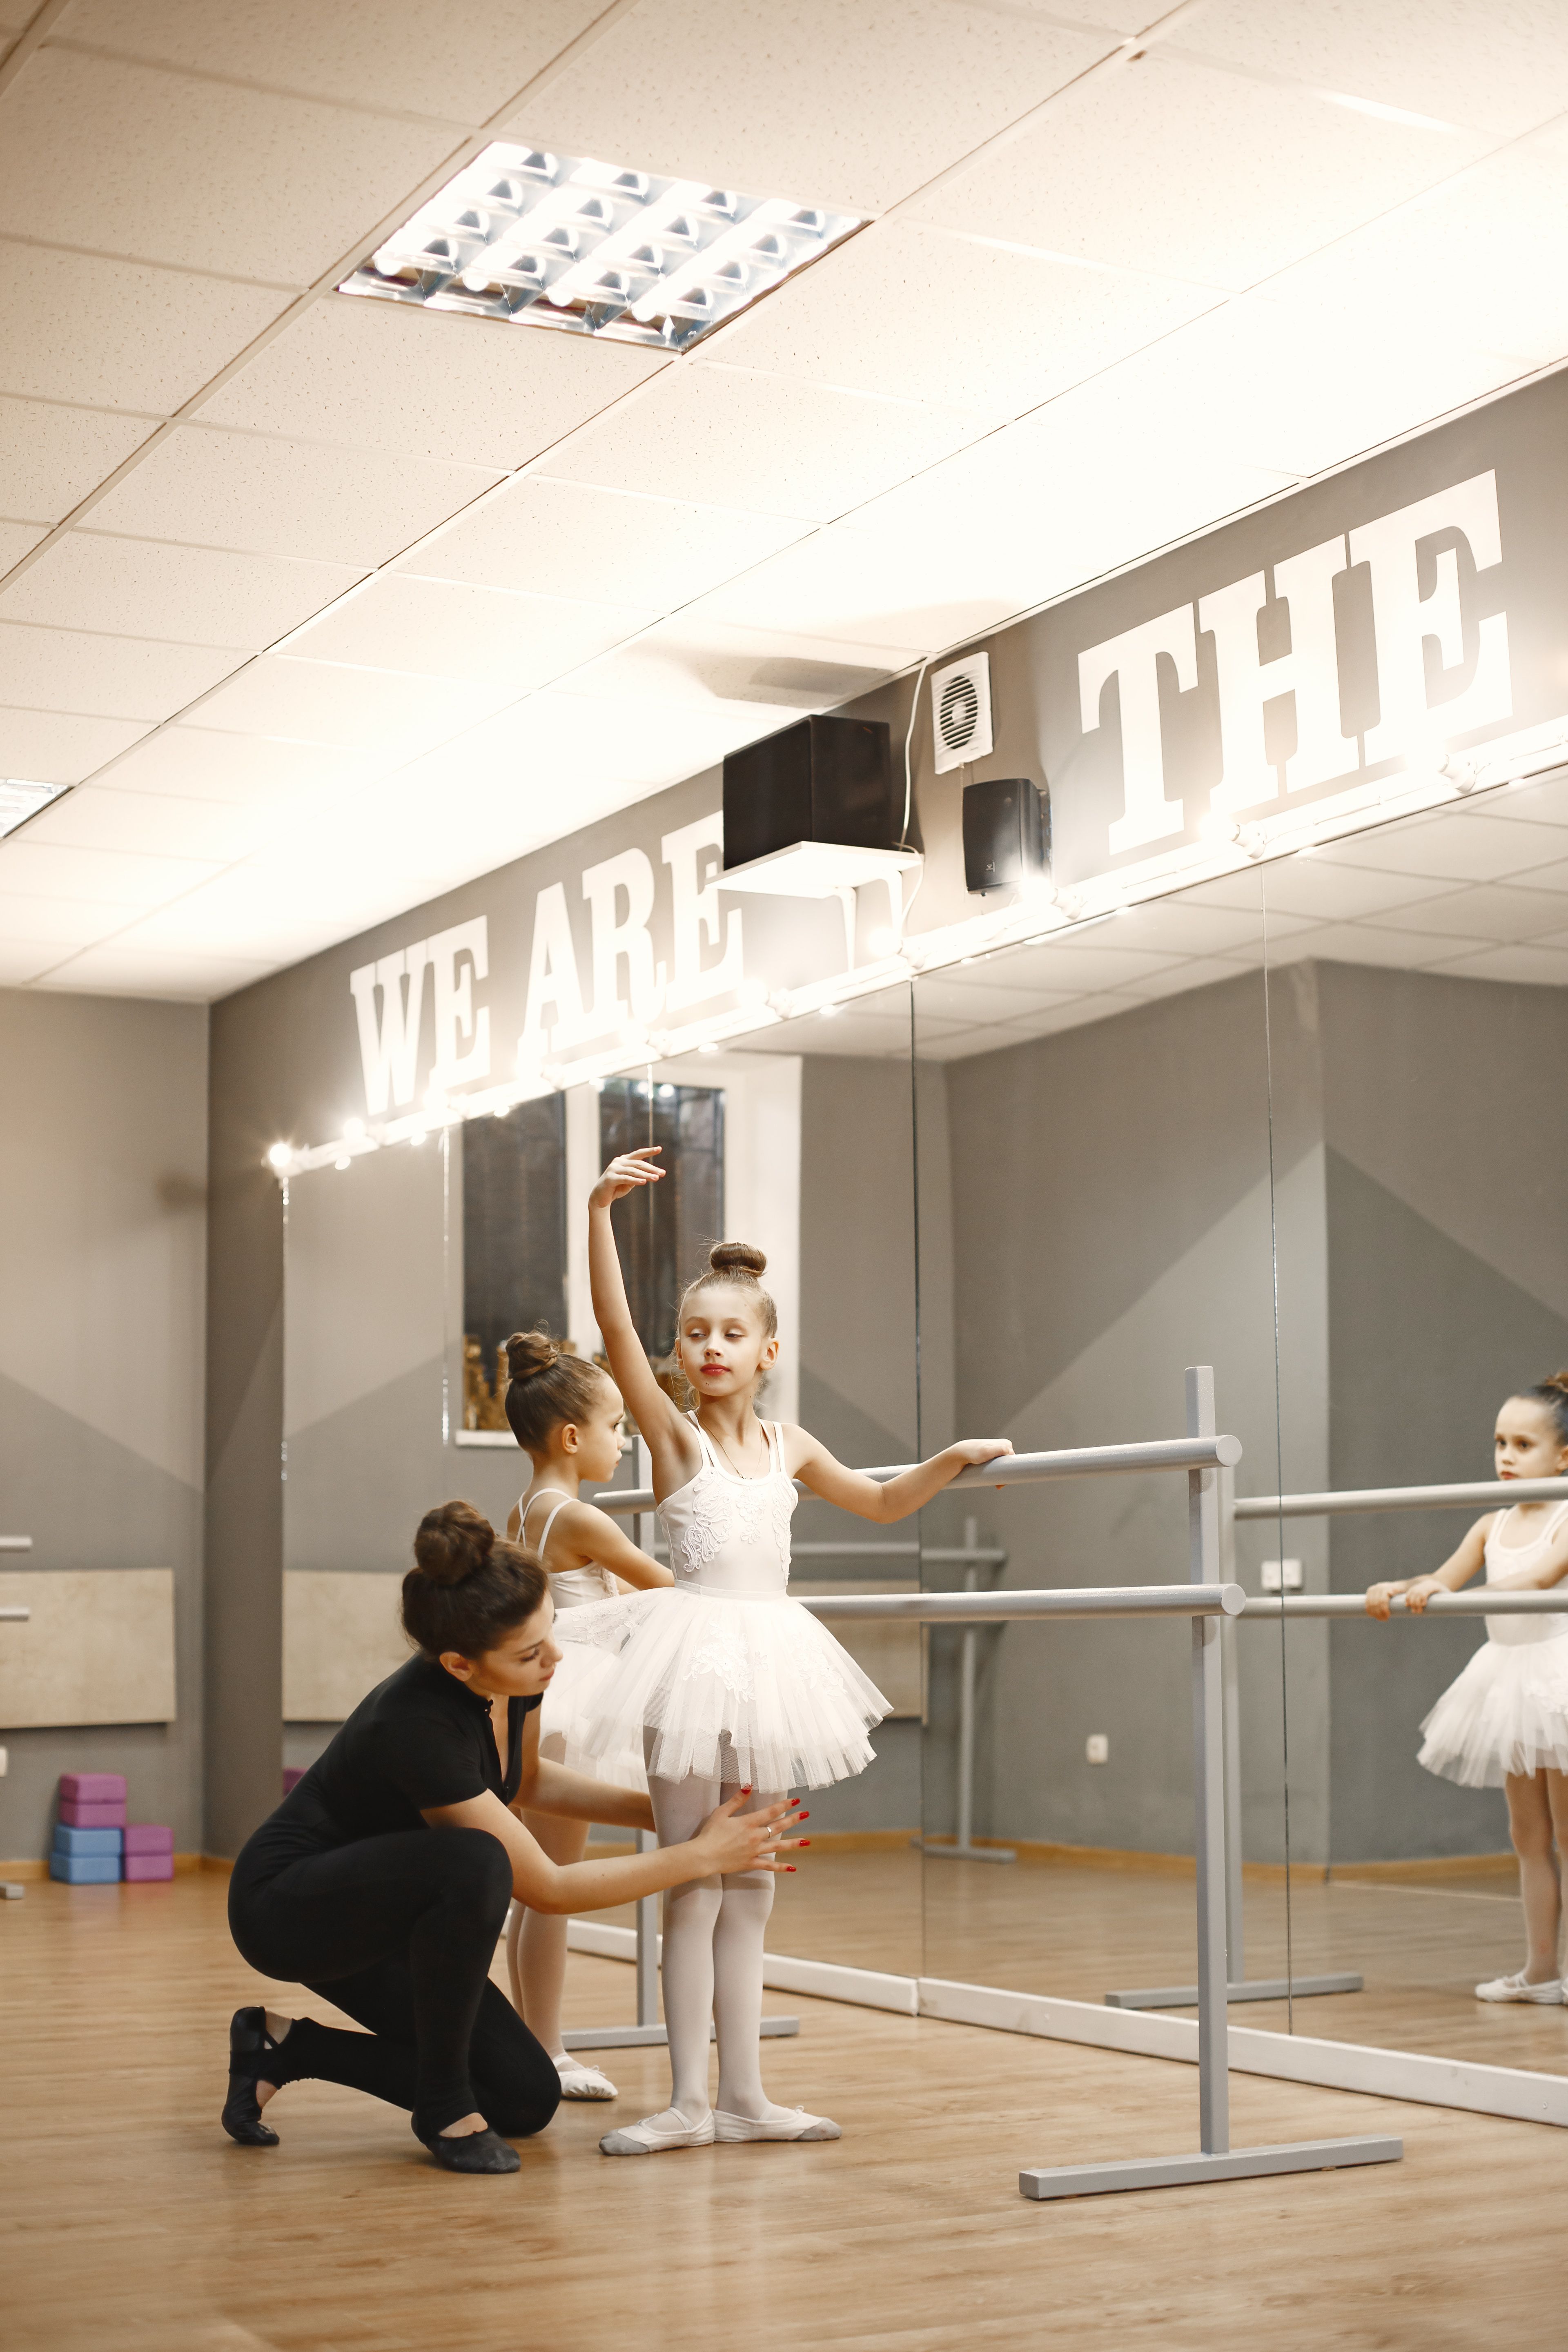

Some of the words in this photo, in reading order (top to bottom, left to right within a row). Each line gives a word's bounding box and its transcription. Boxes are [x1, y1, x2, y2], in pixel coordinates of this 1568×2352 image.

[350, 915, 491, 1116] WE
[517, 811, 742, 1062] ARE
[1077, 468, 1513, 856] THE
